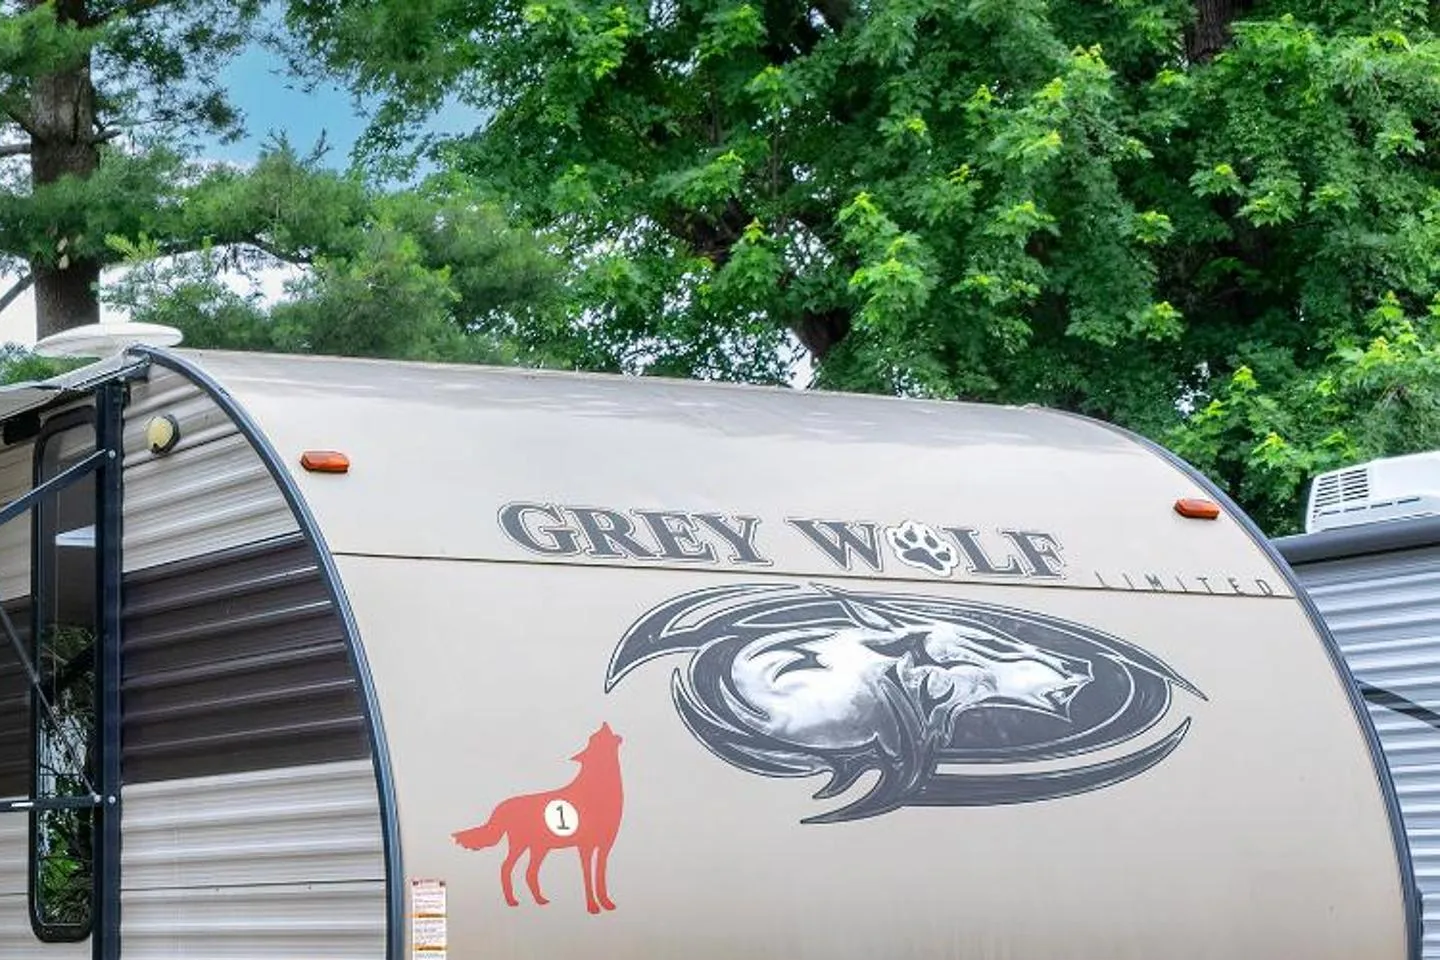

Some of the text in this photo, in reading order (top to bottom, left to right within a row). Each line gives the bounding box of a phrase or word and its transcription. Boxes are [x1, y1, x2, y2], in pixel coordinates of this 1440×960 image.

[496, 502, 774, 567] GREY
[1094, 569, 1274, 598] LIMITED
[556, 804, 570, 830] 1
